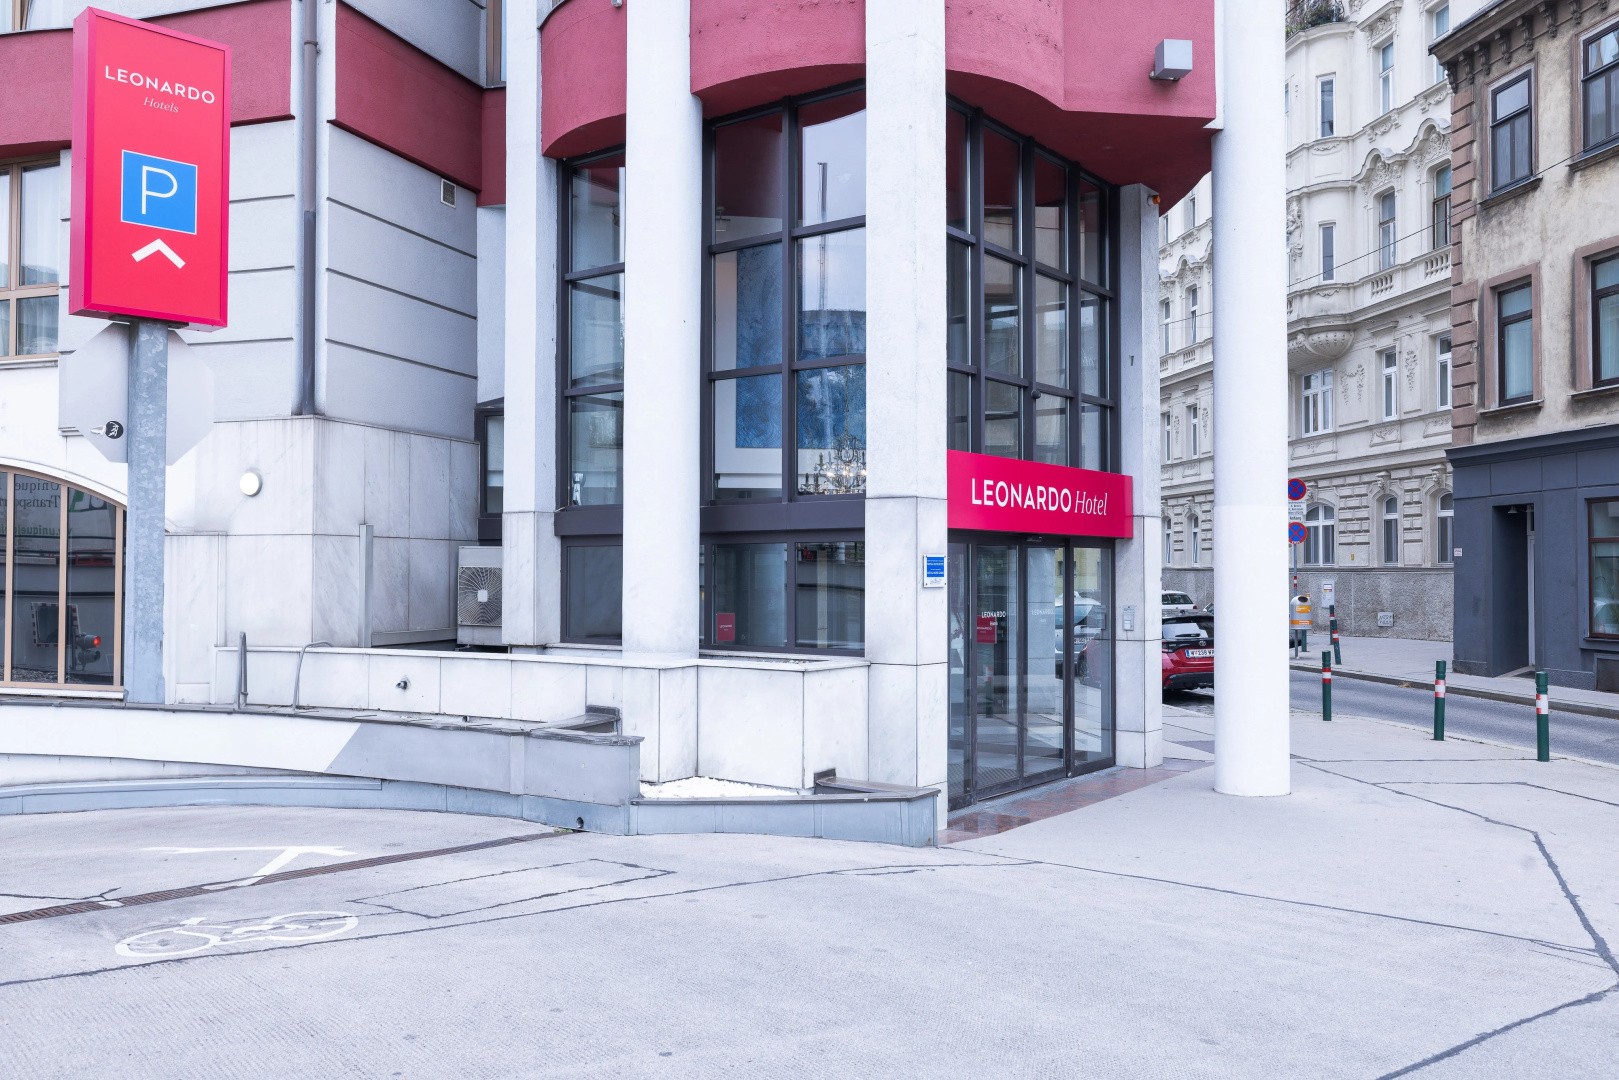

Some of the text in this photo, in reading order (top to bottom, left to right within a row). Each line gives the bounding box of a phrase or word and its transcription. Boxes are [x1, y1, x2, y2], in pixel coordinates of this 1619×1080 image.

[105, 65, 215, 104] LEONARDO
[143, 96, 179, 113] Hotels
[141, 165, 178, 215] P
[971, 478, 1108, 516] LEONARDO Hotel
[982, 610, 1006, 618] LEONARDO
